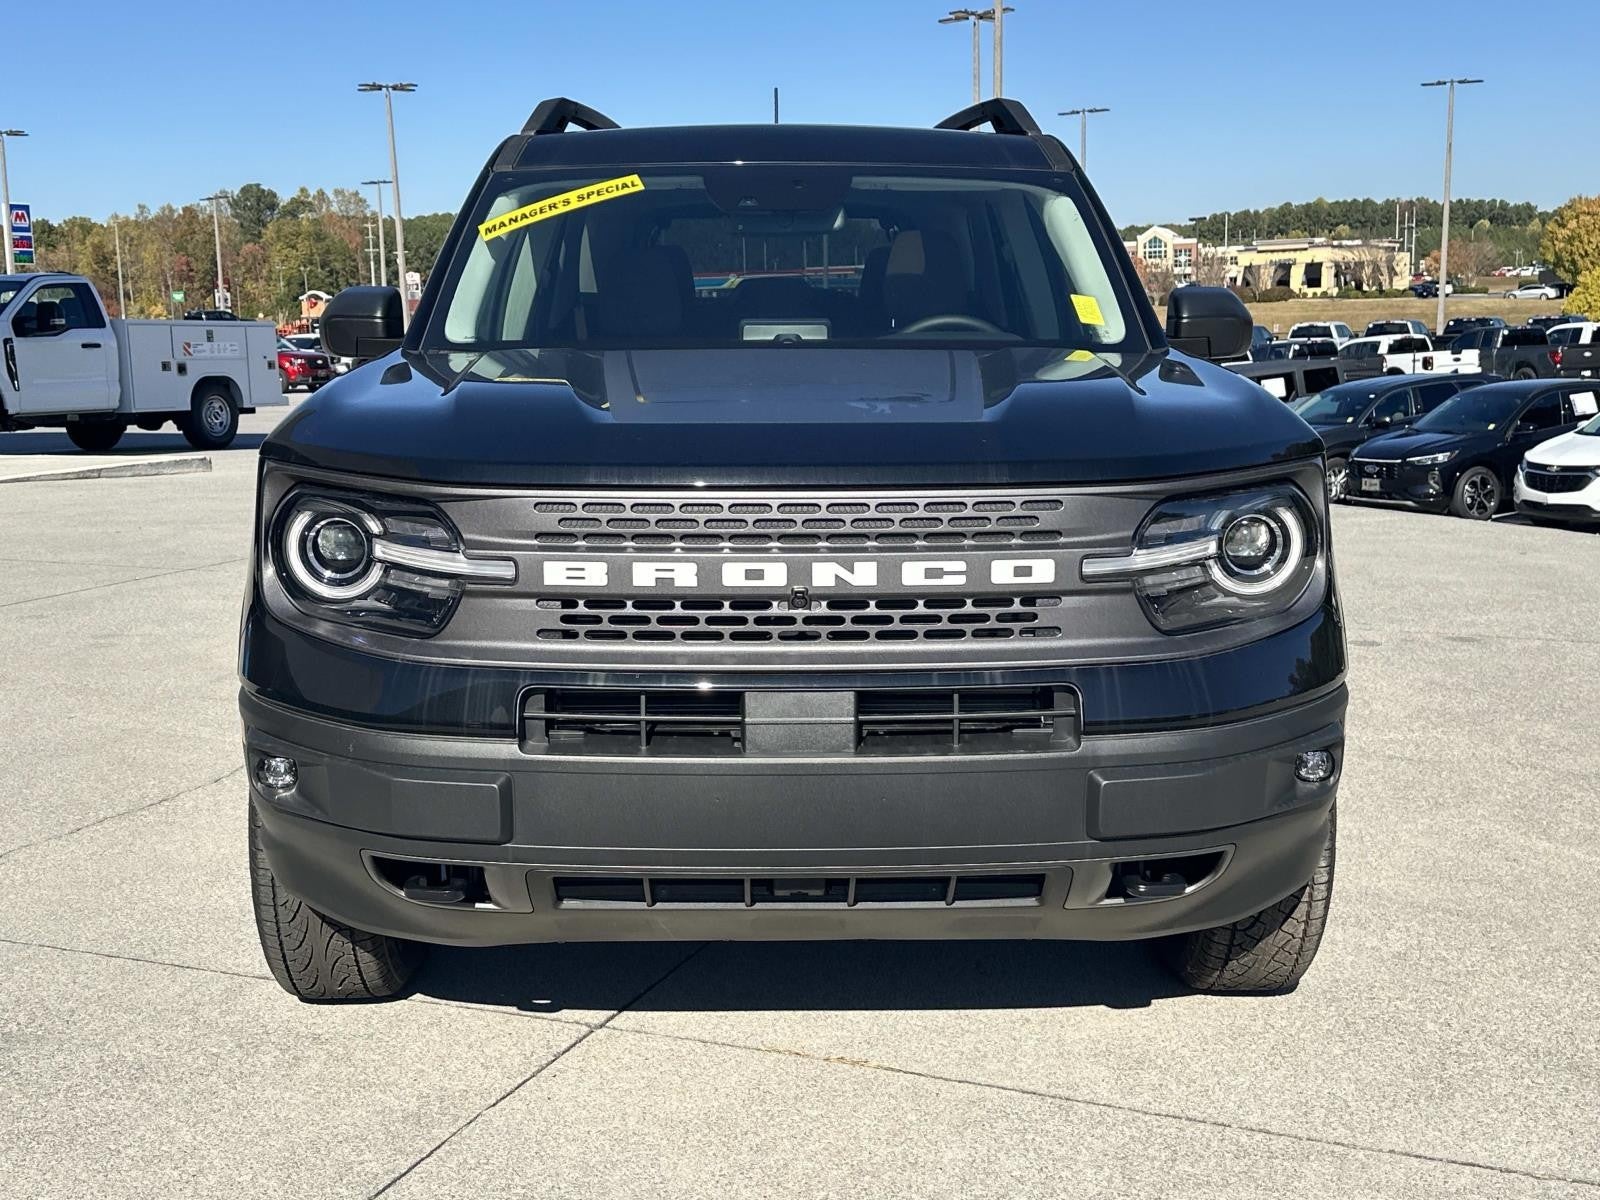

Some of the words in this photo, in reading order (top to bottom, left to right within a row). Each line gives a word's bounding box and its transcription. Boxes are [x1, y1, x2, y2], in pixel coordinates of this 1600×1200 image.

[484, 198, 571, 235] MANAGER'S
[576, 180, 639, 203] SPECIAL
[543, 559, 1055, 587] BRONCO
